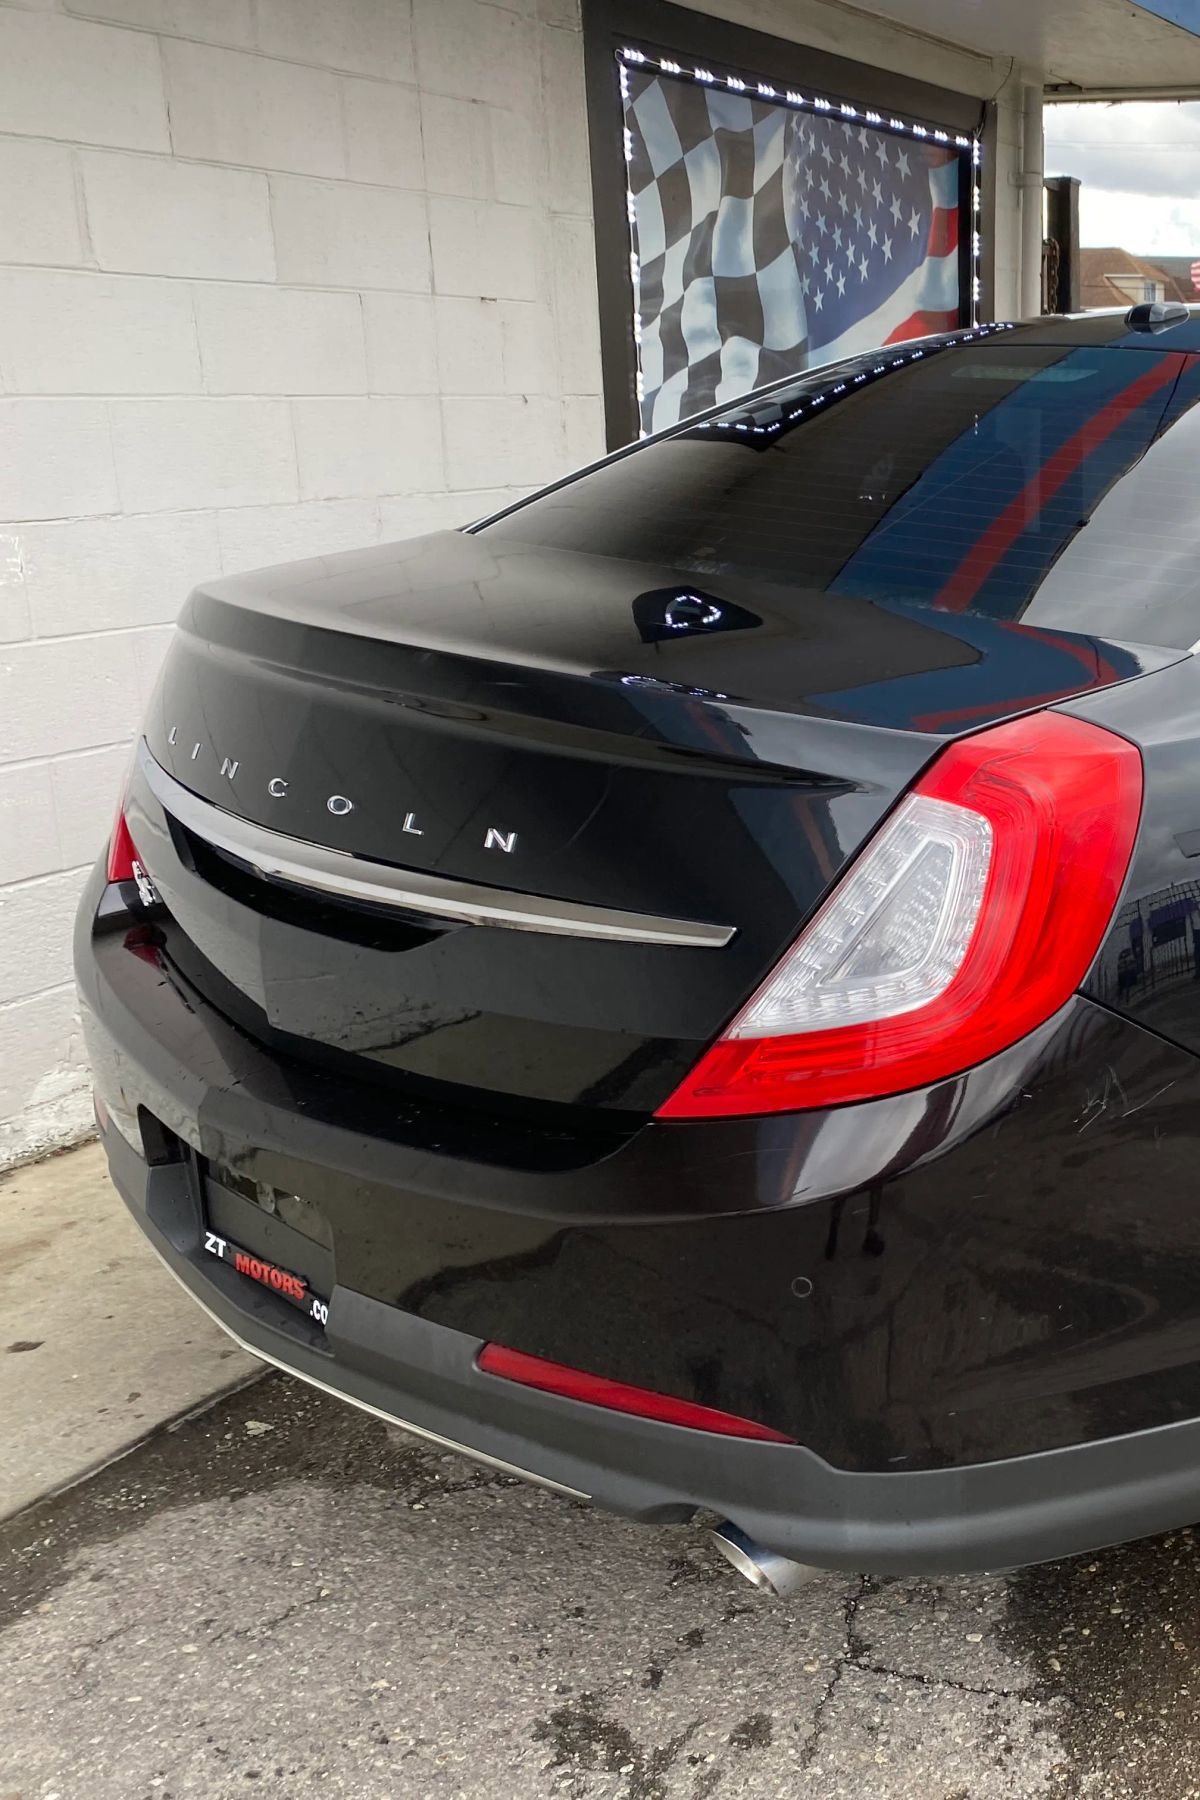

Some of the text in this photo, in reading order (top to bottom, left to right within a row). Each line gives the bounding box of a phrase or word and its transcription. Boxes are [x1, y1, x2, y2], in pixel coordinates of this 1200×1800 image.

[167, 727, 518, 853] LINCOLN
[204, 1231, 227, 1258] ZT
[235, 1252, 307, 1300] MOTORS
